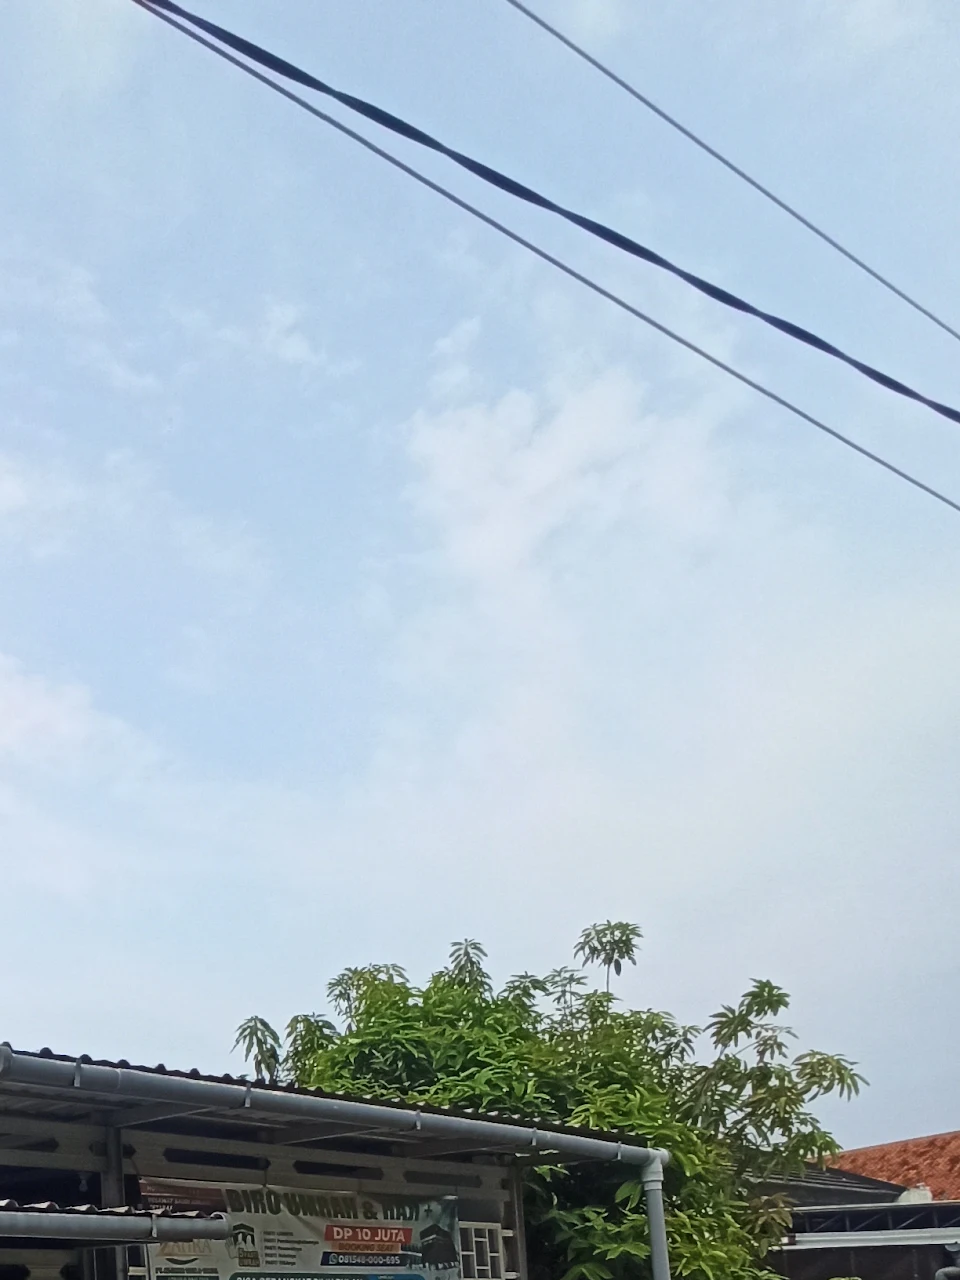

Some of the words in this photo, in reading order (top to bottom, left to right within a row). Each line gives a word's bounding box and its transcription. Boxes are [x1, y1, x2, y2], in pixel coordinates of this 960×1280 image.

[226, 1189, 282, 1215] BIRO
[363, 1201, 378, 1220] &
[333, 1227, 353, 1240] DP
[356, 1228, 371, 1241] 10
[374, 1228, 405, 1242] JUTA
[338, 1242, 376, 1252] BOOKING
[377, 1243, 394, 1252] SEAT
